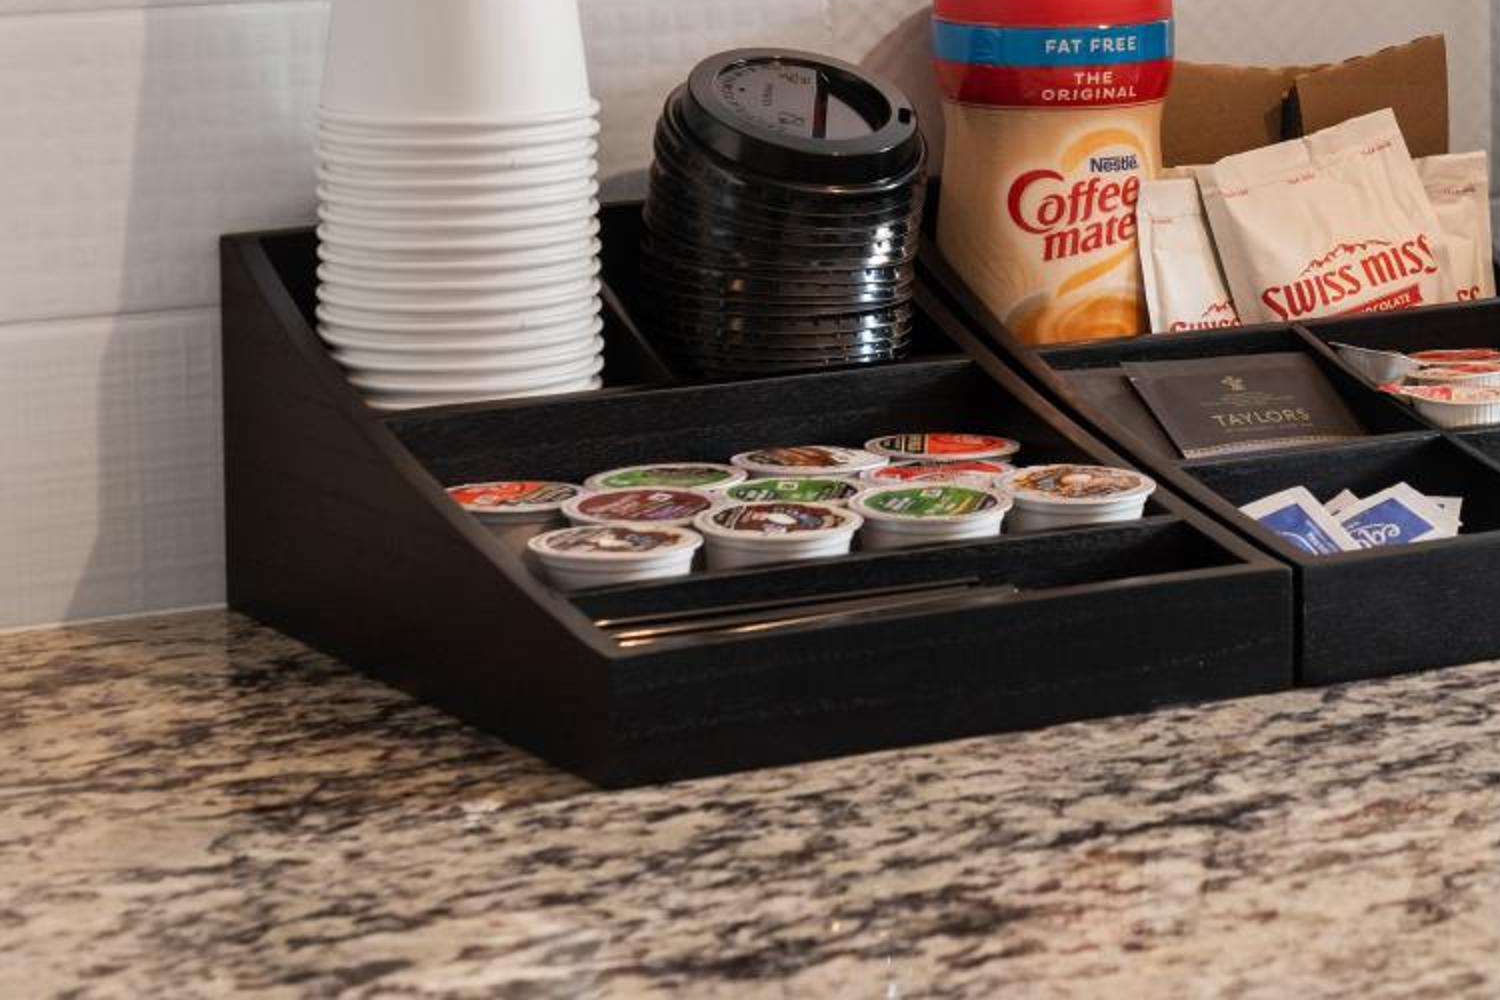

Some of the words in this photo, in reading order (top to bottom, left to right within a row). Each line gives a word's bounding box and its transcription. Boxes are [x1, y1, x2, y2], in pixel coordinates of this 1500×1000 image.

[1045, 39, 1082, 55] FAT
[1089, 35, 1137, 53] FREE
[1073, 71, 1113, 85] THE
[1041, 86, 1137, 101] ORIGINAL
[1008, 169, 1140, 234] Coffee
[1043, 213, 1137, 261] mate
[1262, 265, 1361, 321] SWISS
[1208, 407, 1311, 427] TAYLORS
